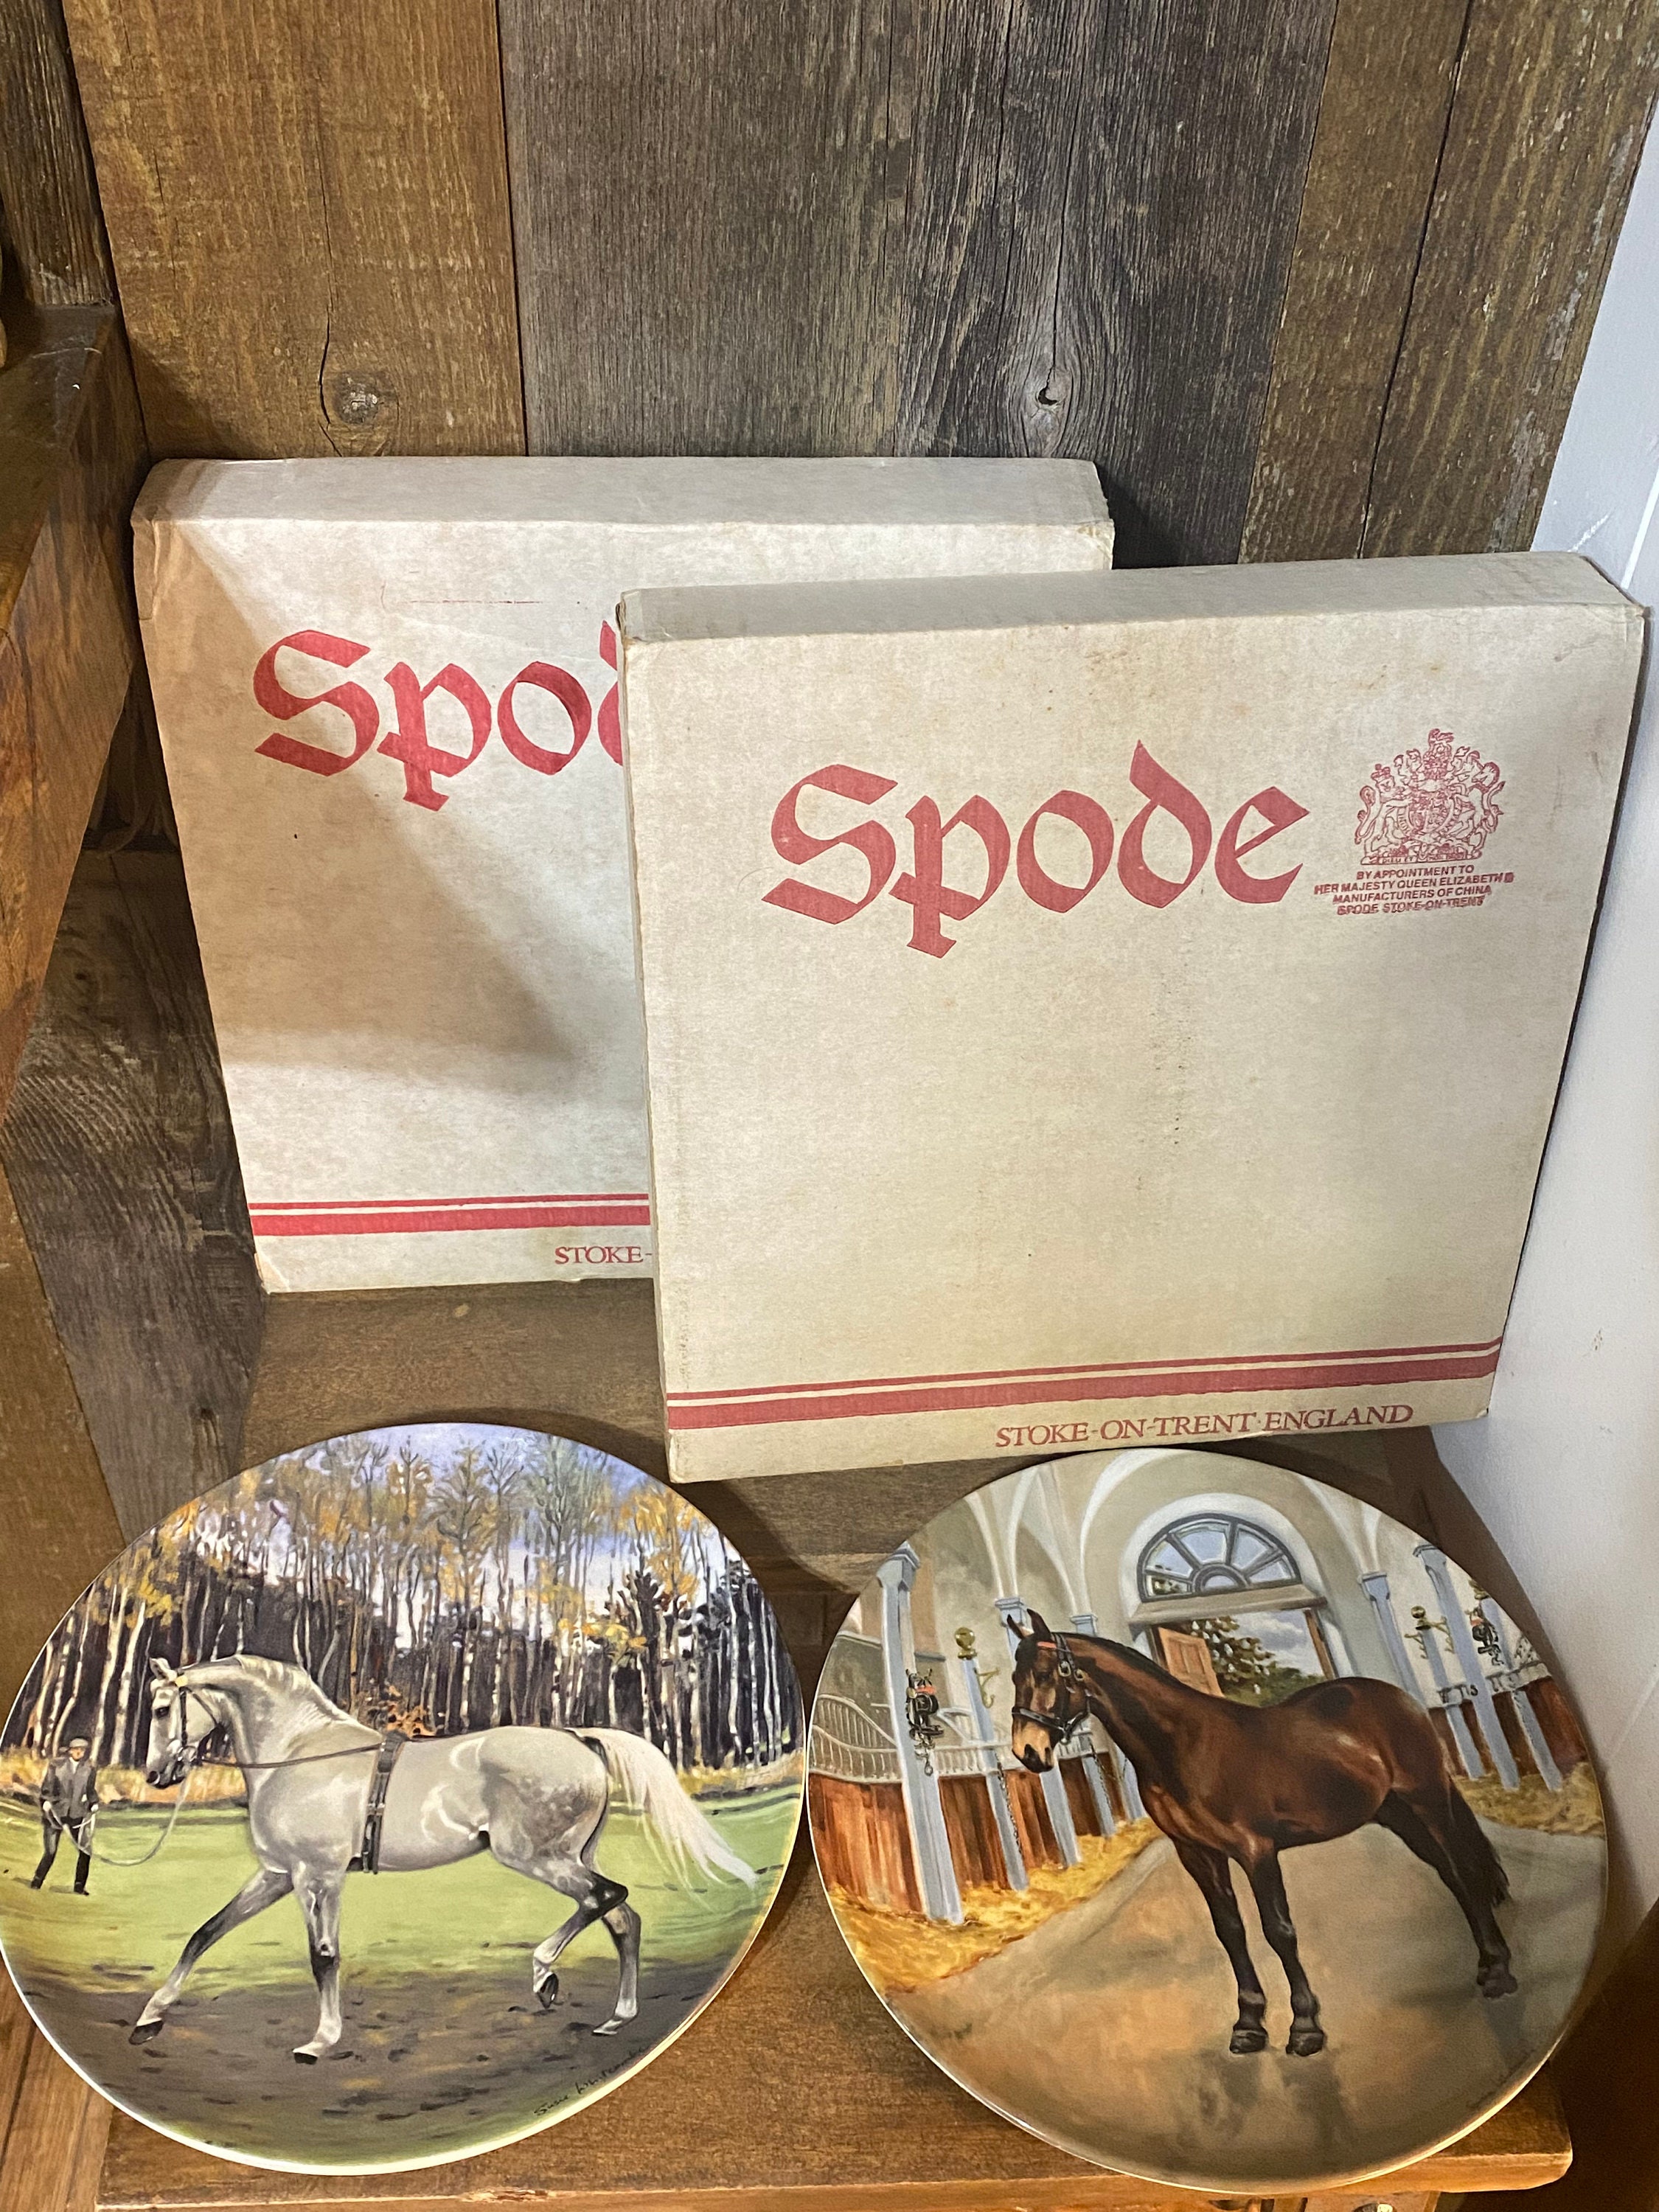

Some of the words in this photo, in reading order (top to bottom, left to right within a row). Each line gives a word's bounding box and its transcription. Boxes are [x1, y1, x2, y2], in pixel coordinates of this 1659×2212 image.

[761, 740, 1310, 959] Spode
[1314, 883, 1339, 894] HER
[1341, 880, 1396, 893] MAJESTY
[1397, 877, 1437, 889] QUEEN
[1439, 872, 1503, 886] ELIZABETH
[1356, 871, 1372, 880] BY
[1373, 866, 1457, 880] APPOINTMENT
[1458, 864, 1475, 874] TO
[1332, 888, 1435, 905] MANUFACTURERS
[1437, 887, 1454, 897] OF
[1455, 884, 1492, 897] CHINA
[1262, 1404, 1413, 1431] ENGLAND
